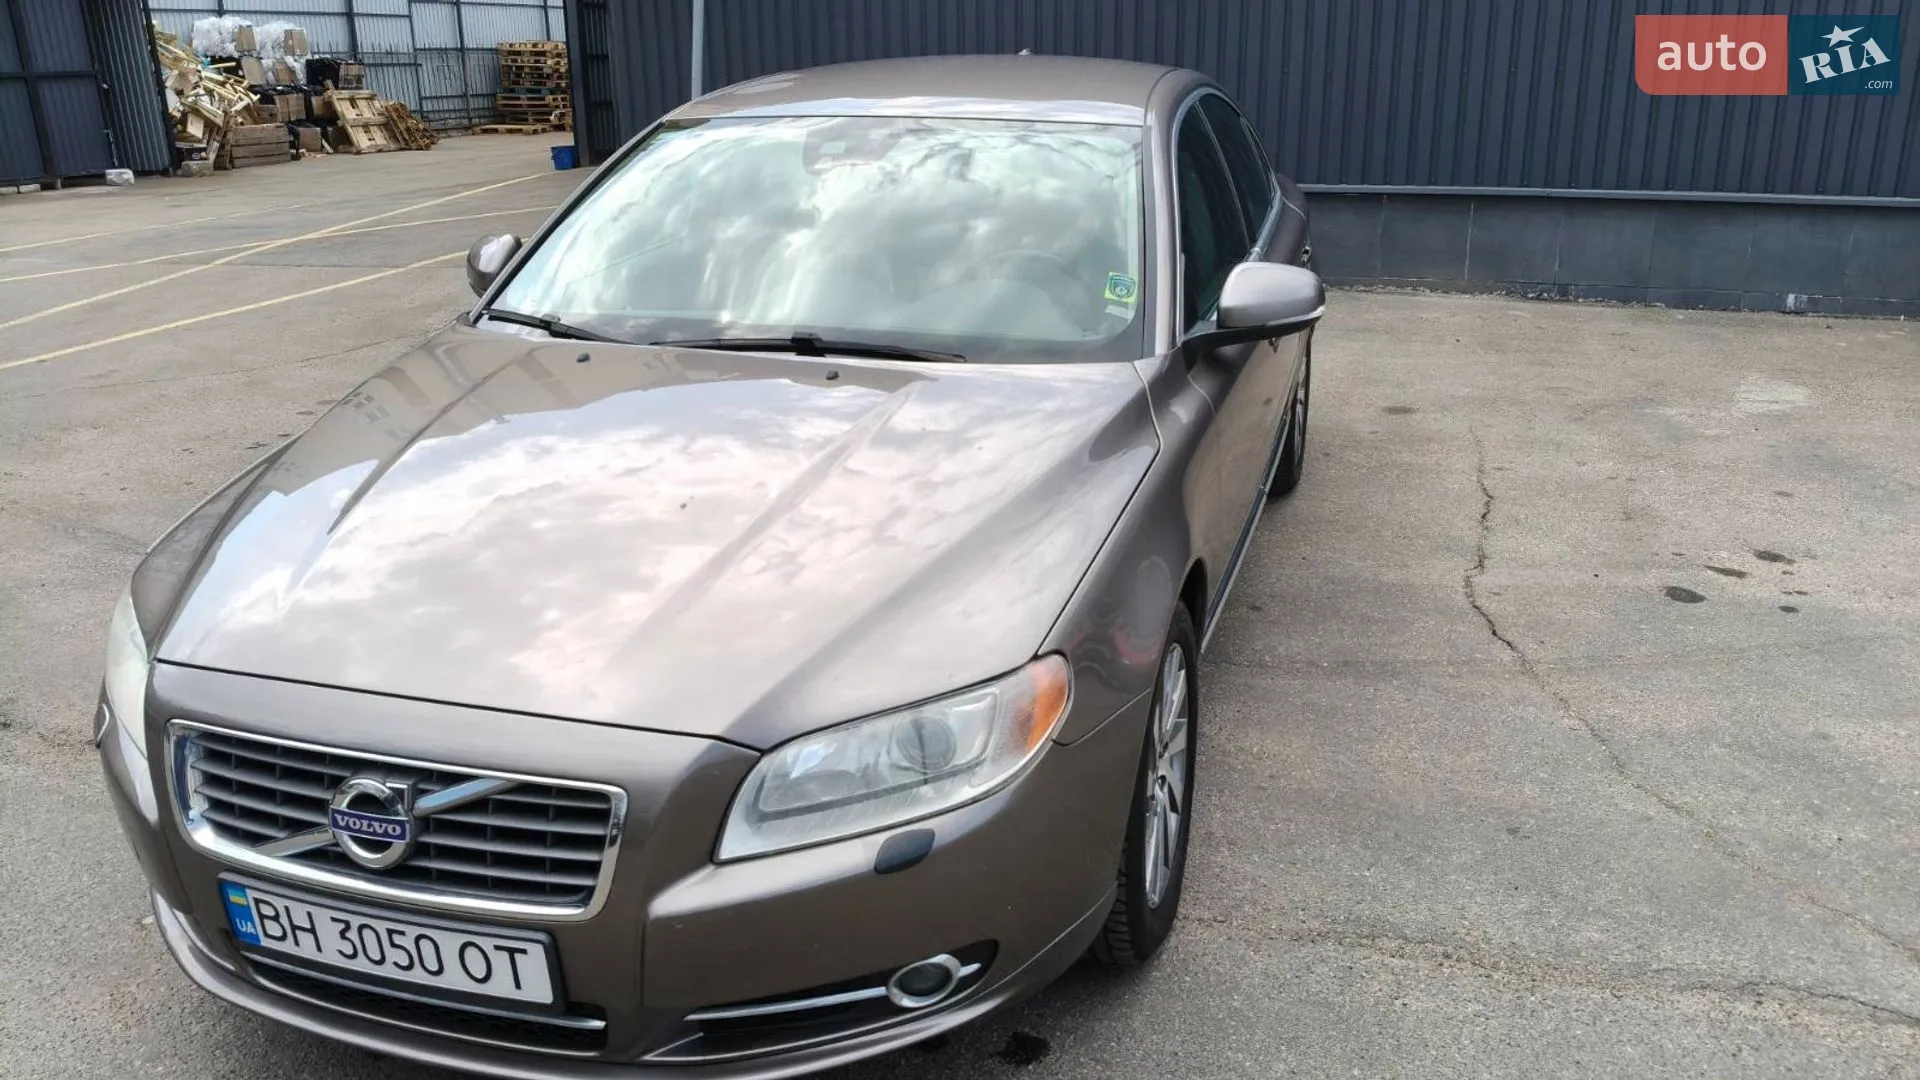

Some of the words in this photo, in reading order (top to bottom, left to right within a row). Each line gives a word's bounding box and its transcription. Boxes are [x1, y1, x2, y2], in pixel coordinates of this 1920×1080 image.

[334, 814, 402, 837] VOLVO
[236, 917, 256, 936] UA
[252, 897, 323, 952] BH
[330, 916, 444, 976] 3050
[458, 940, 528, 990] OT
